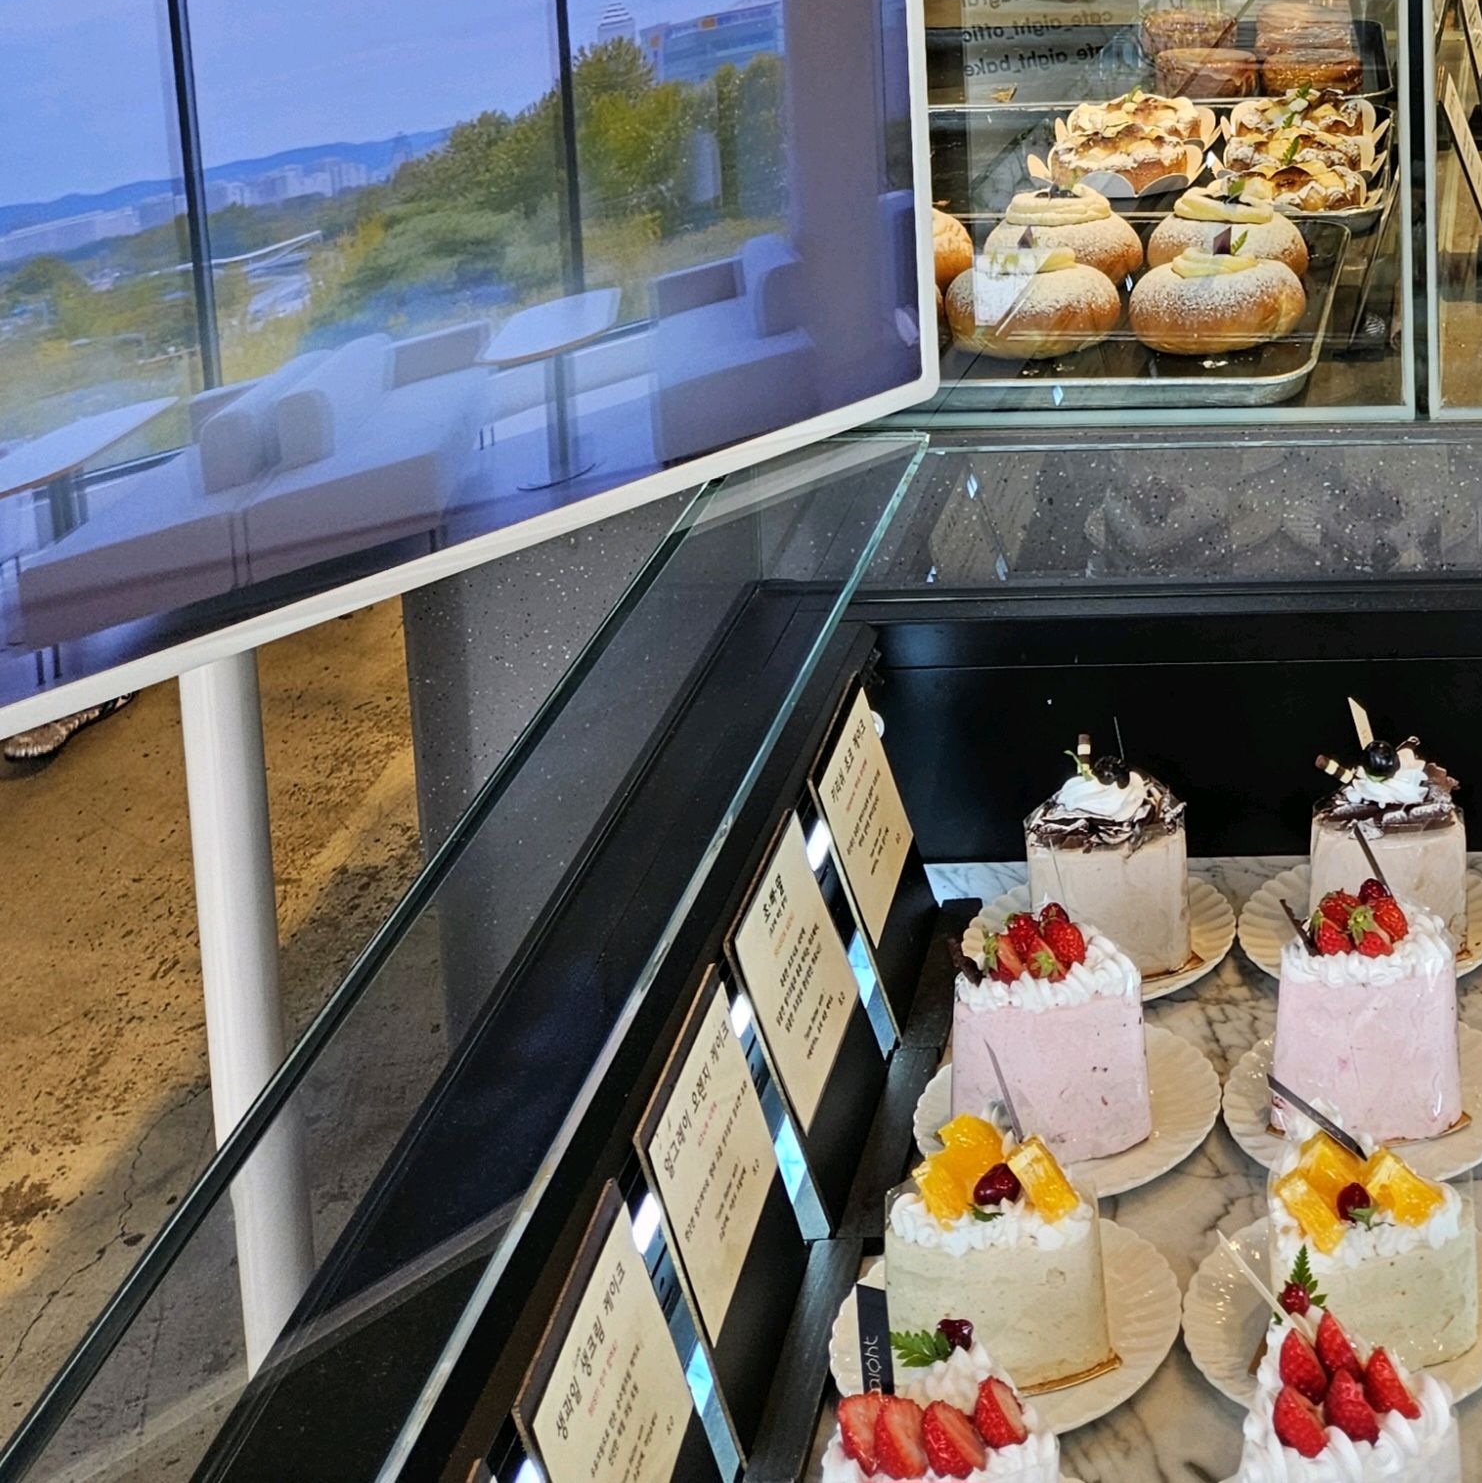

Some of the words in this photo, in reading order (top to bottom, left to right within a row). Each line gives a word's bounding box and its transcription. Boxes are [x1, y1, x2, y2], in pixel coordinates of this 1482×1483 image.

[553, 1371, 583, 1448] 생과일
[577, 1311, 606, 1384] 생크림
[601, 1256, 627, 1321] 케이크
